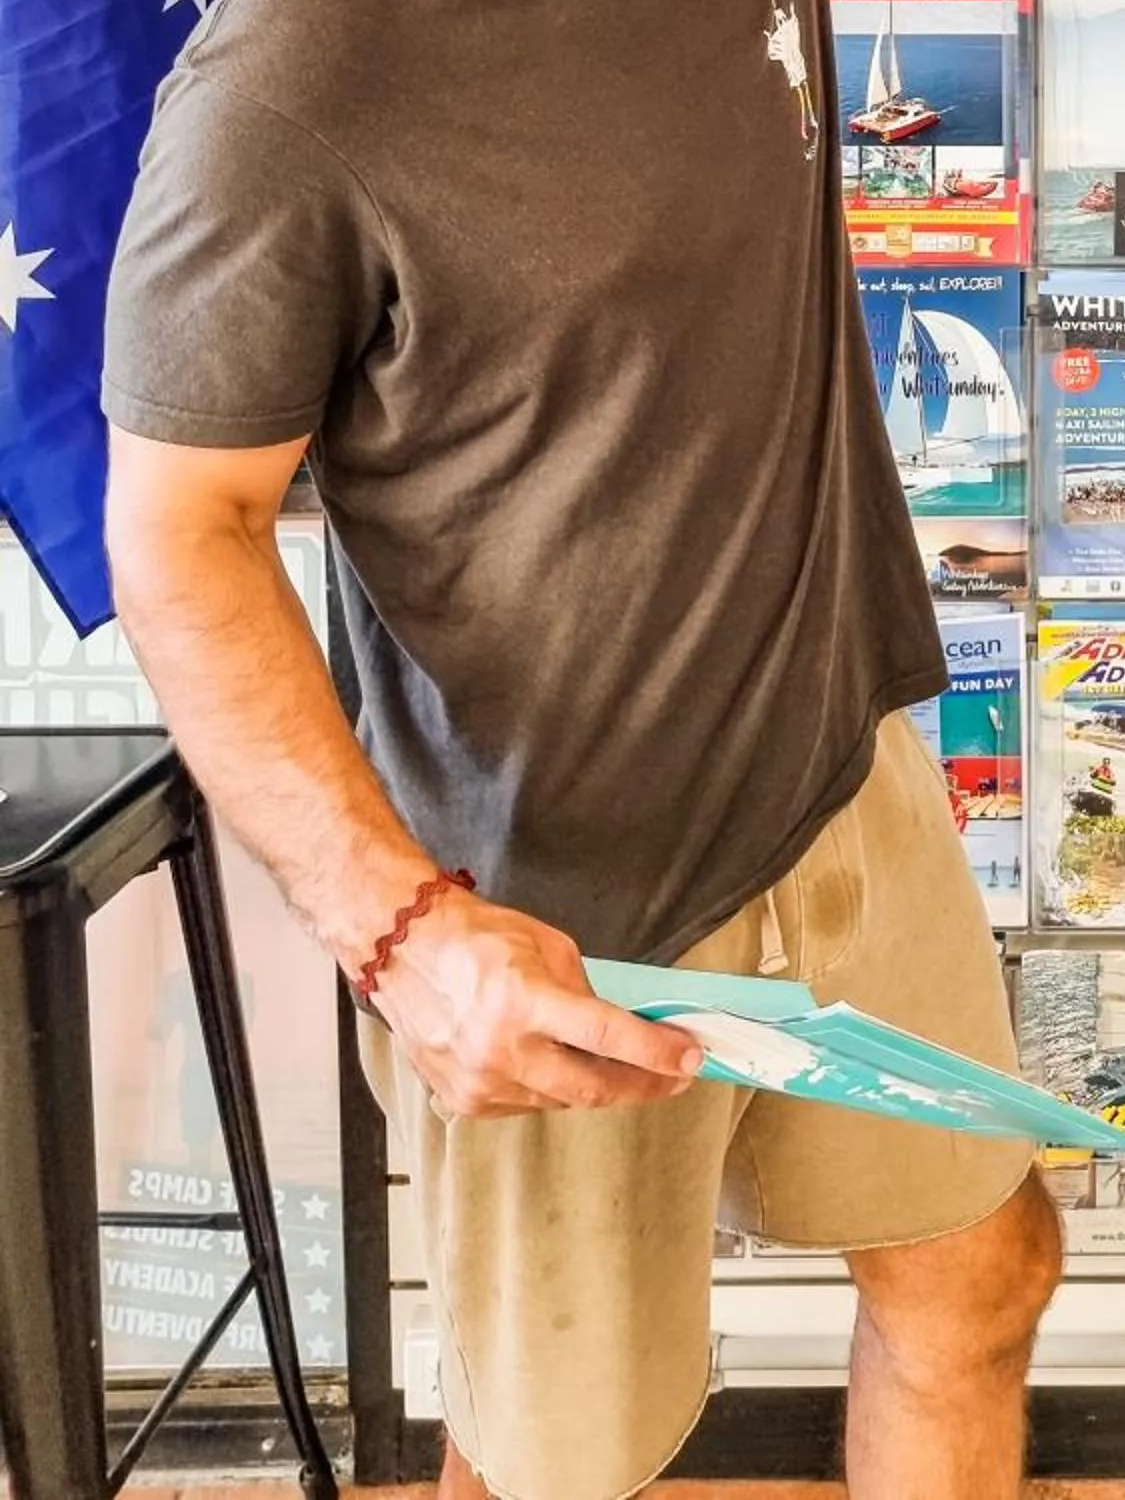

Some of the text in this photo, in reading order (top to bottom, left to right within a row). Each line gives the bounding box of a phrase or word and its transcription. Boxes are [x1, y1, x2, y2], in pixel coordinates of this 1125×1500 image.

[1060, 356, 1090, 368] FREE
[945, 638, 1002, 659] cean
[952, 678, 1014, 692] FUN DAY
